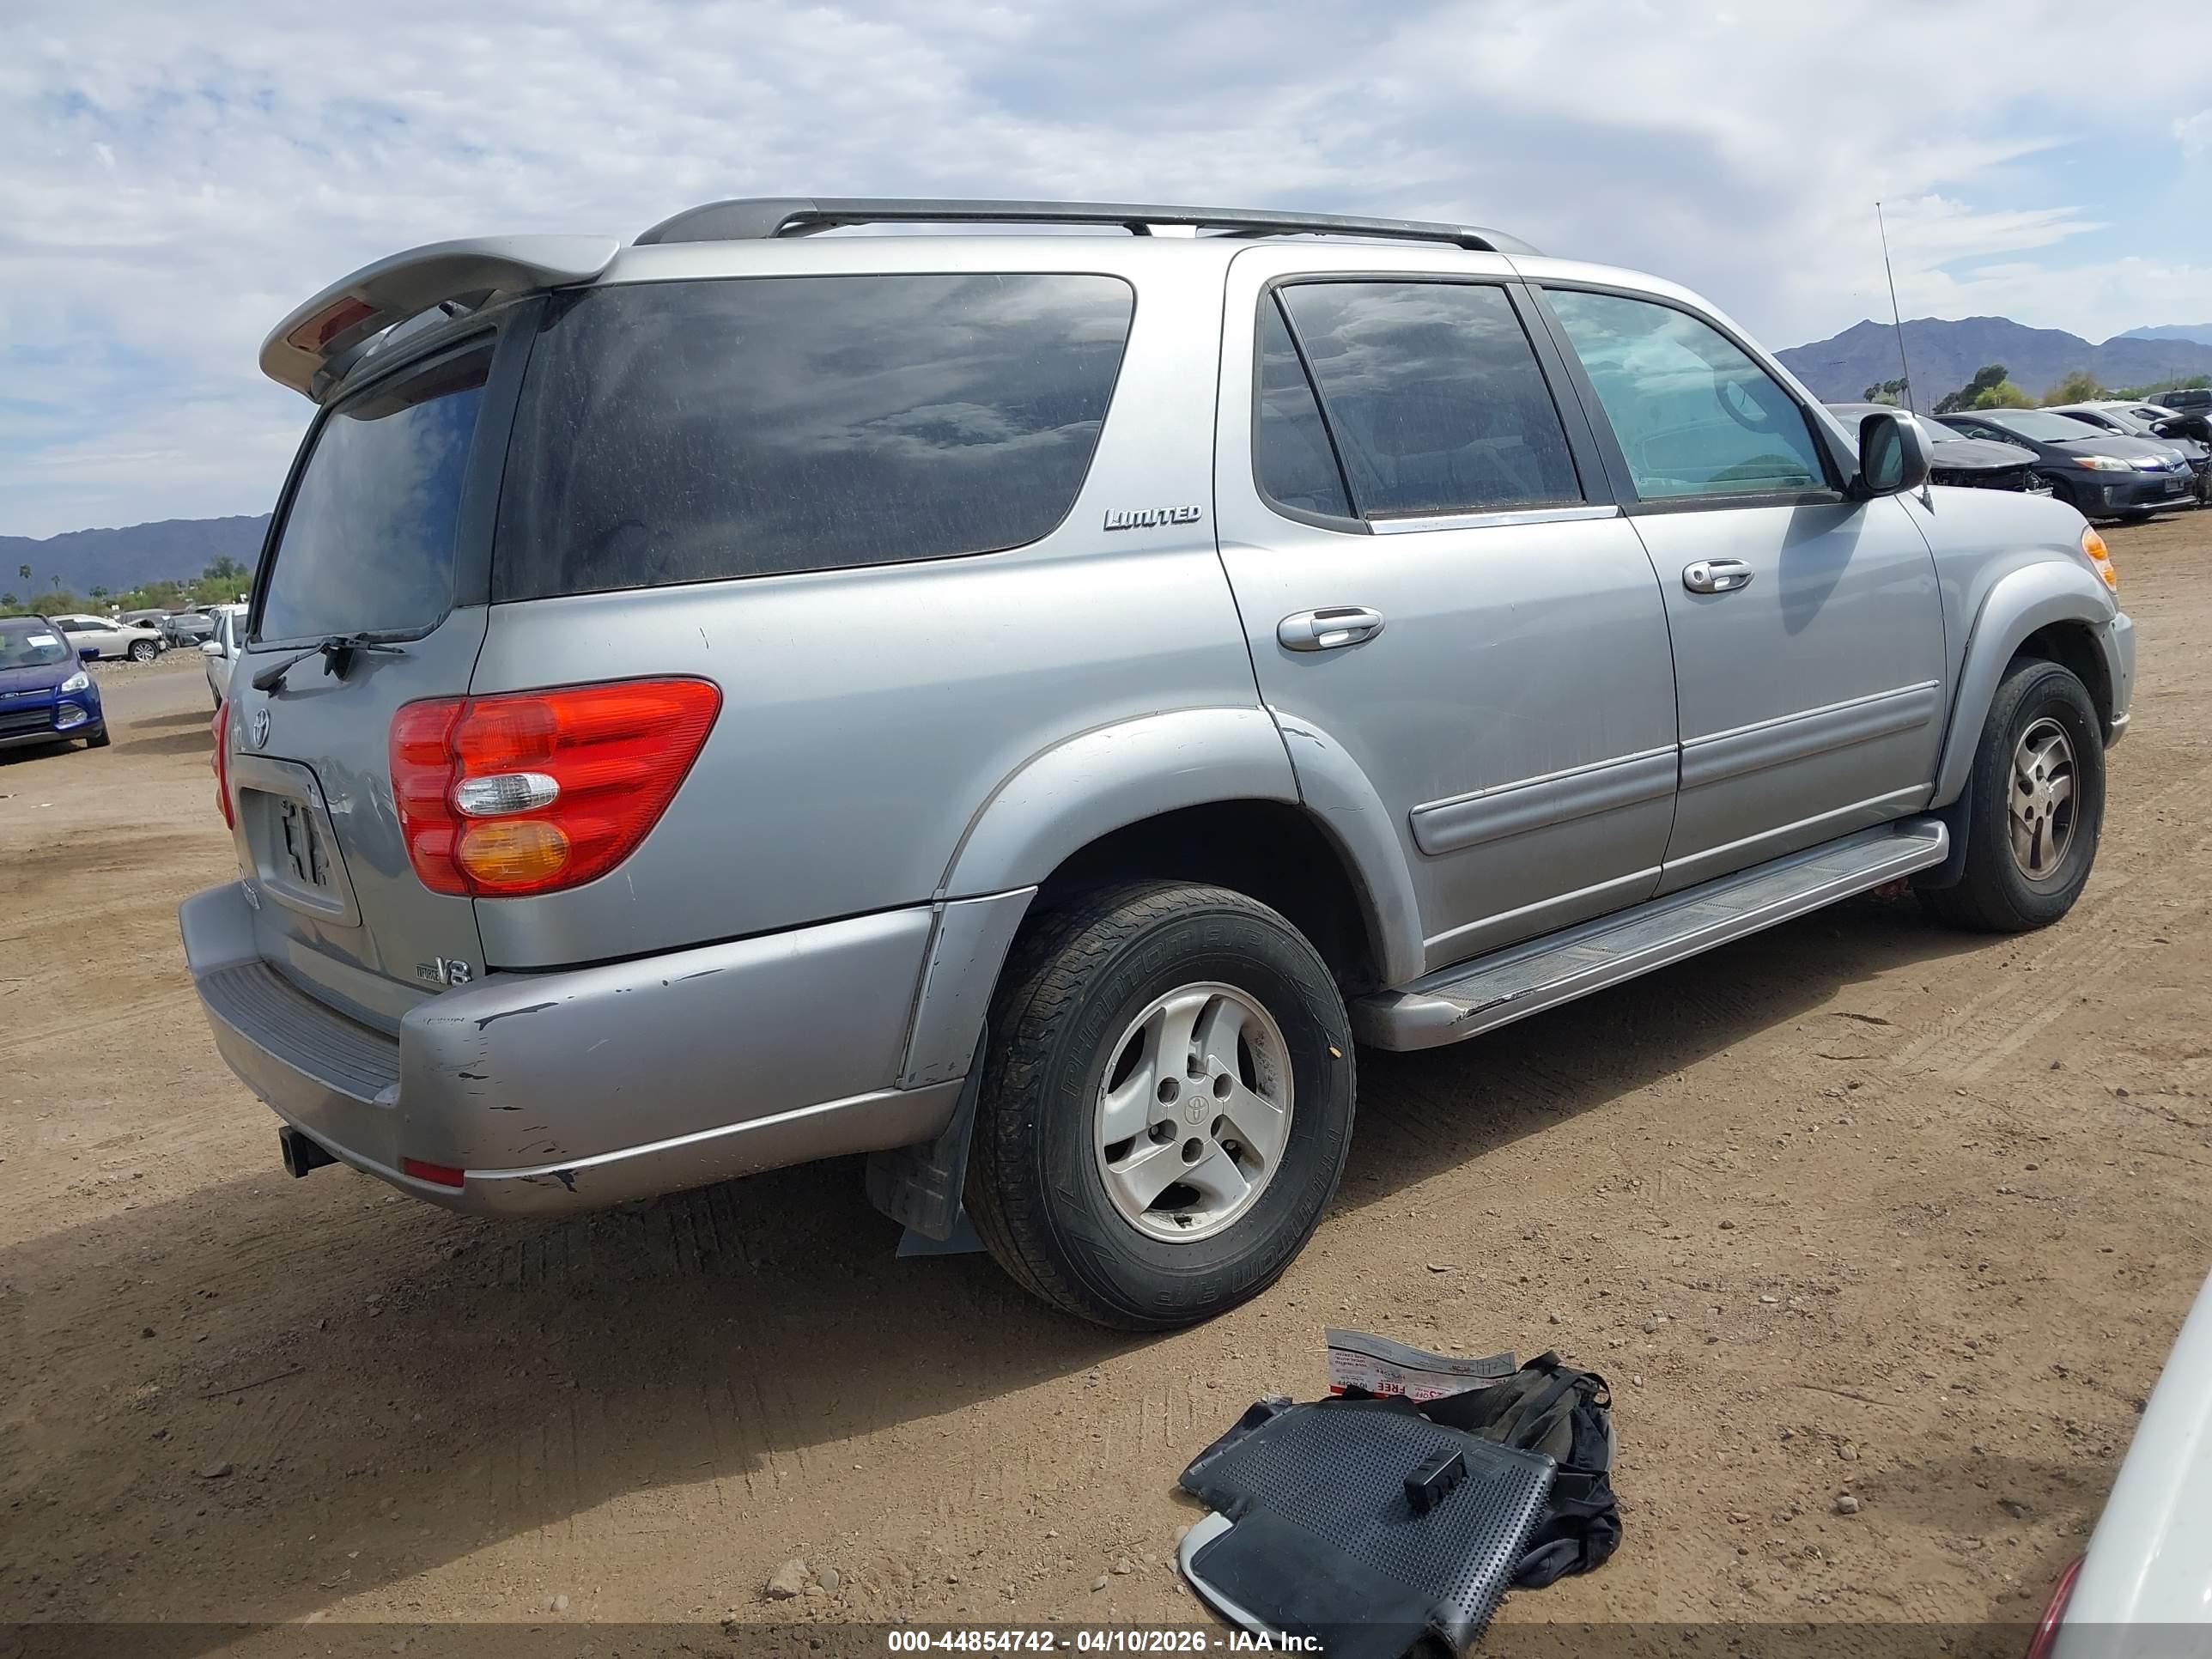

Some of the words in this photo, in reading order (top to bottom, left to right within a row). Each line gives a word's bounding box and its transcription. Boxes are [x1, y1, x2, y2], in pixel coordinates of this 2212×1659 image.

[1103, 505, 1202, 532] LIMITED
[434, 957, 471, 985] V8
[1377, 1382, 1406, 1395] FREE
